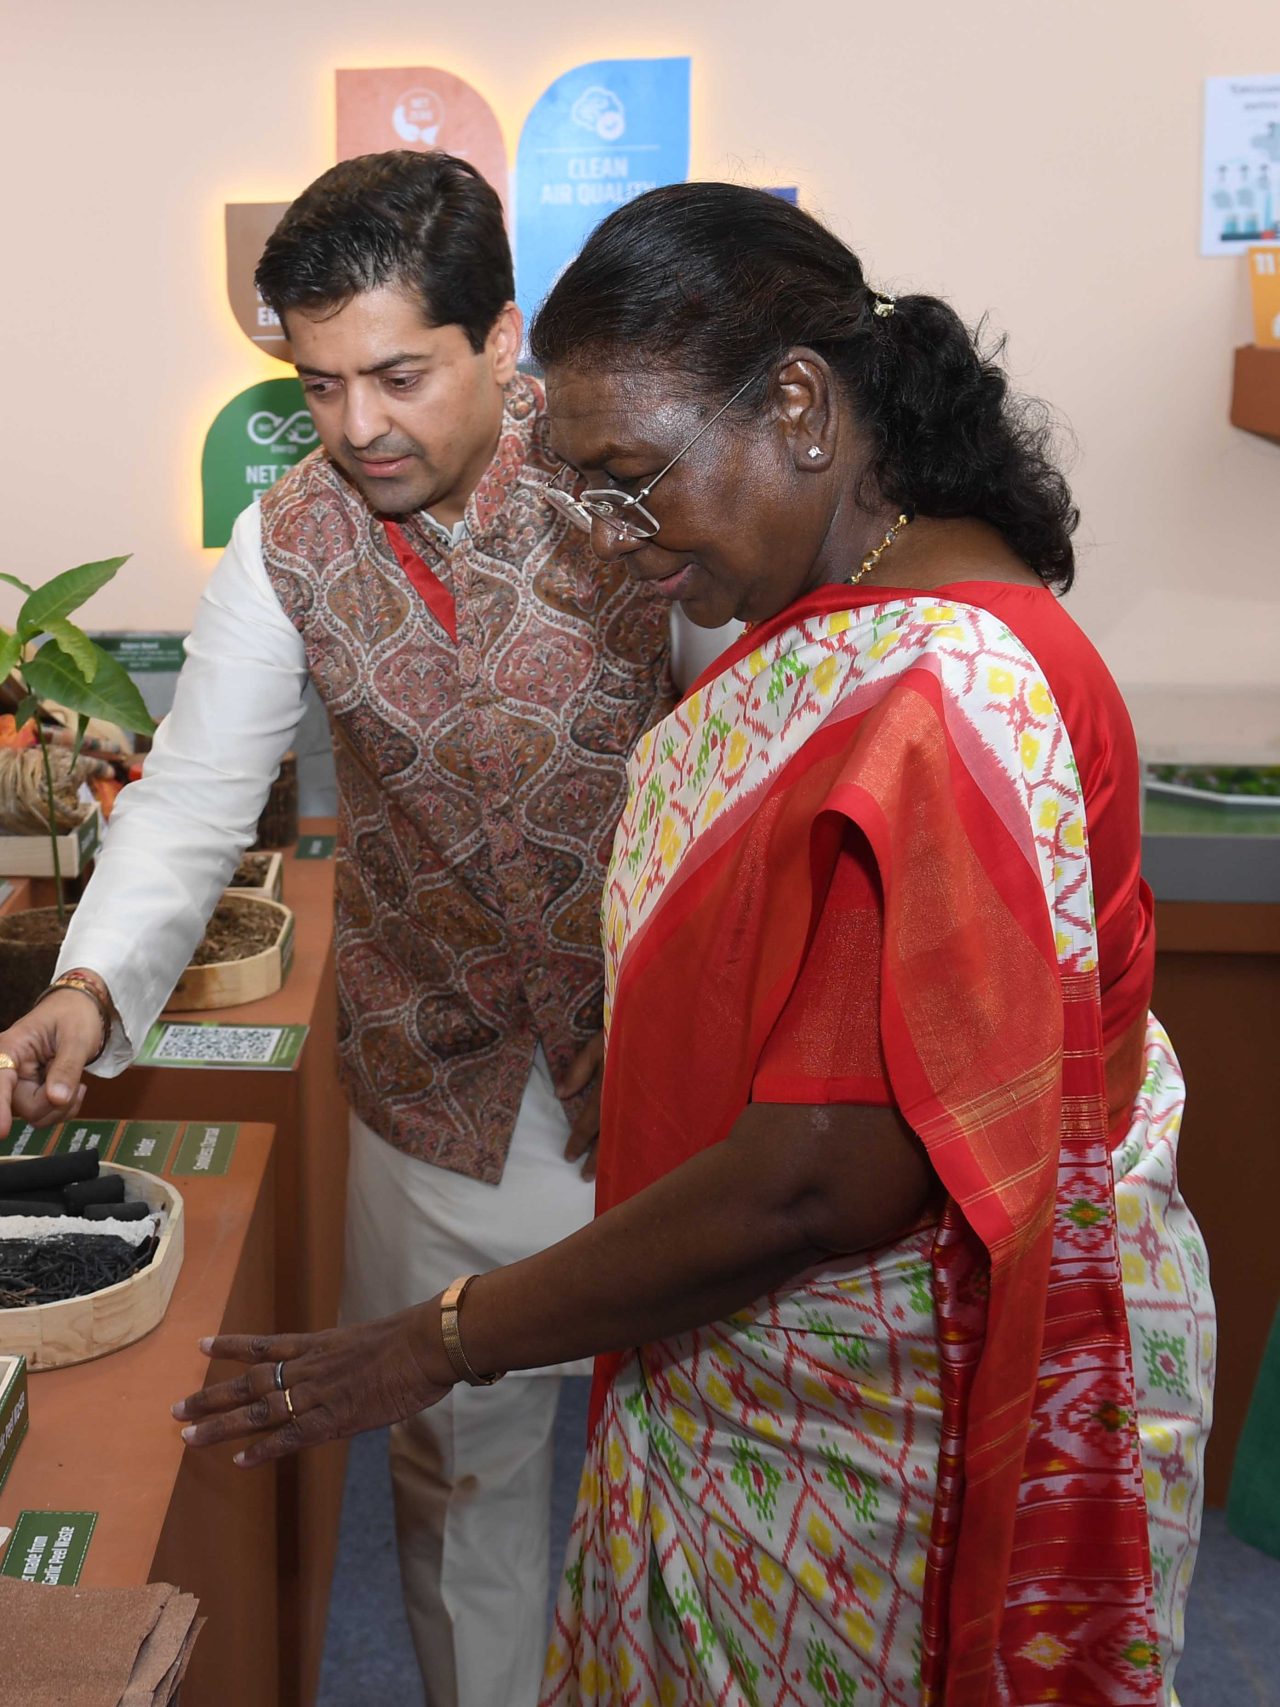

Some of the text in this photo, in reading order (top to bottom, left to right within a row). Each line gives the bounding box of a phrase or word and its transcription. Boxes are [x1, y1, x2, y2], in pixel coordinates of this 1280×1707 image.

[567, 157, 629, 179] CLEAN
[542, 184, 572, 205] AIR
[245, 465, 278, 484] NET
[27, 1536, 48, 1553] from
[53, 1526, 75, 1547] Waste
[23, 1554, 42, 1574] made
[48, 1548, 67, 1564] Peel
